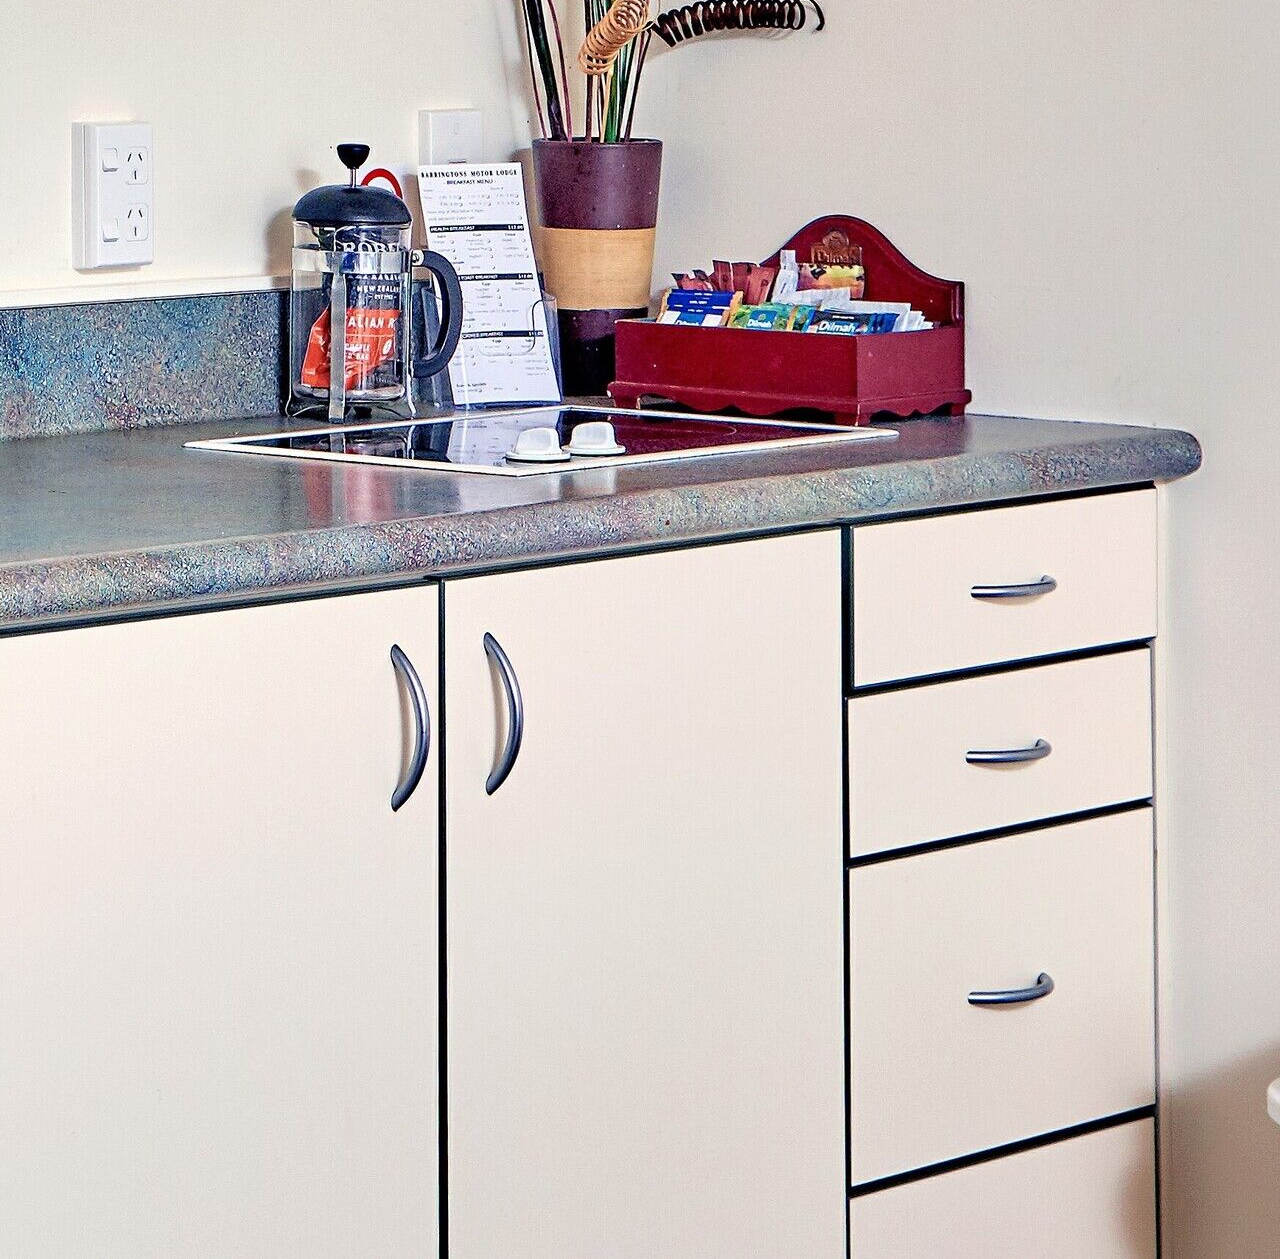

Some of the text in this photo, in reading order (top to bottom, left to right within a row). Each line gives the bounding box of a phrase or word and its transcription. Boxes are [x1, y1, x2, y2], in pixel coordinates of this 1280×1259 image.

[346, 317, 384, 329] ALIAN
[747, 319, 772, 329] Dilmah
[819, 321, 855, 333] Dilmah
